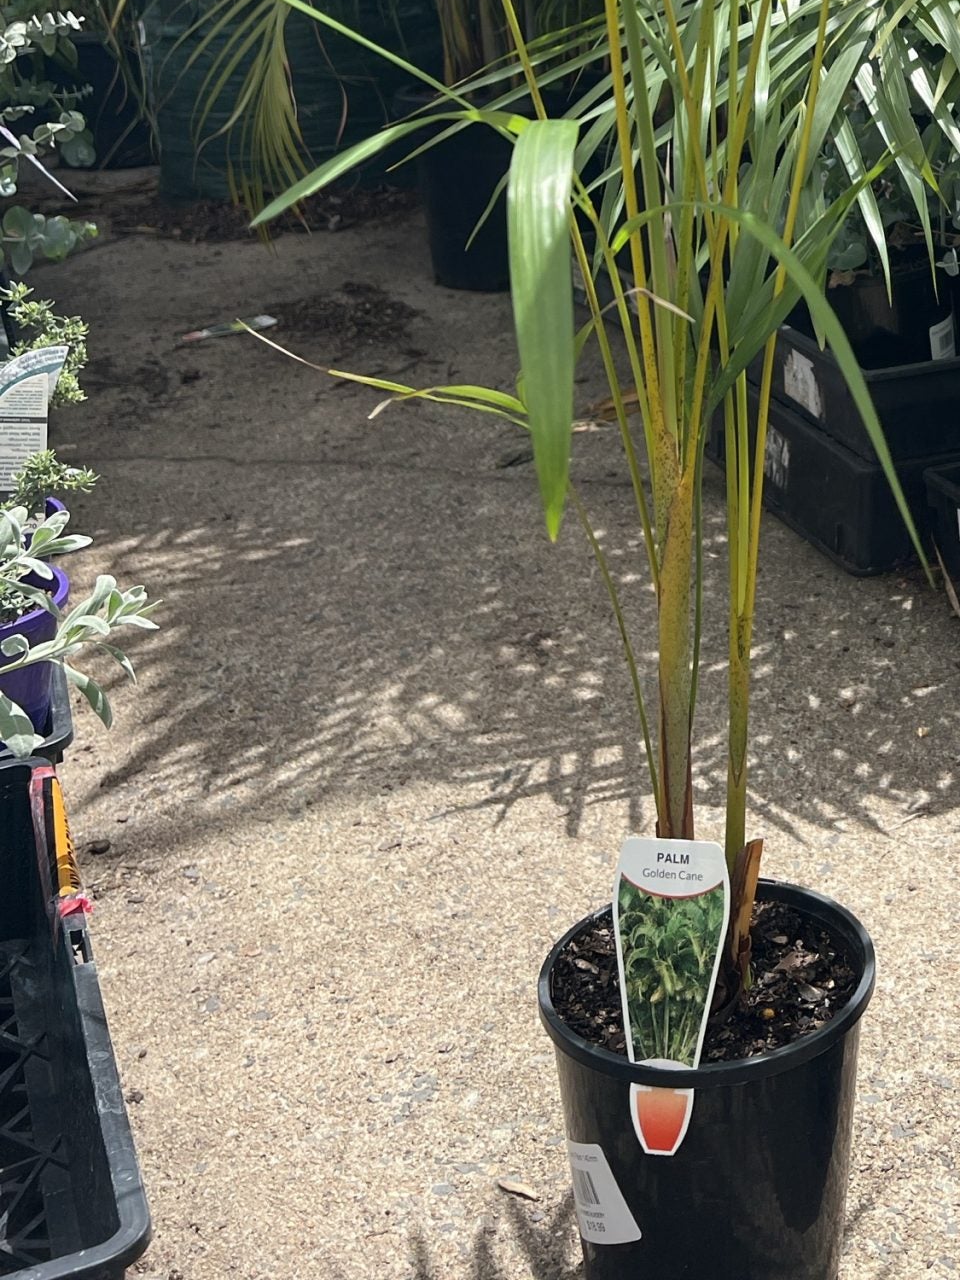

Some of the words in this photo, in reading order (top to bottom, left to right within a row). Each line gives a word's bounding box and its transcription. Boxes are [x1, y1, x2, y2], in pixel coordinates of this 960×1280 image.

[656, 852, 690, 865] PALM
[642, 867, 677, 880] Golden
[678, 870, 703, 881] Cane
